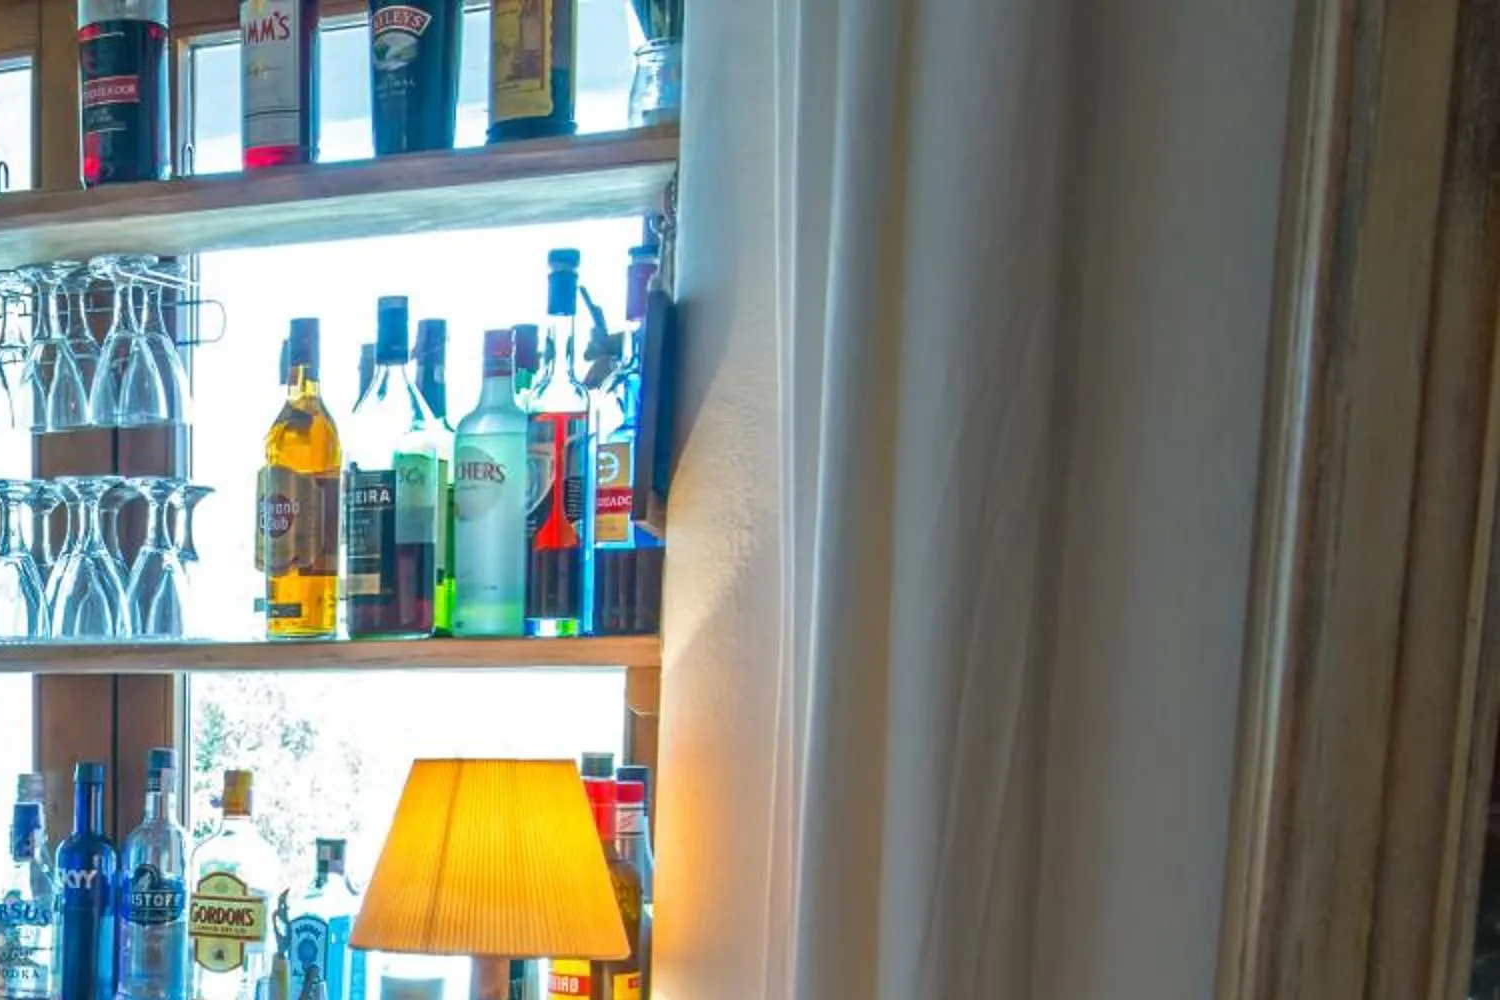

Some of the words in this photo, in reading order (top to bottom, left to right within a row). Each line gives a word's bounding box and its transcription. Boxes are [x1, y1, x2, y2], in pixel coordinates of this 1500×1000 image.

[242, 11, 290, 46] IMM'S
[374, 9, 424, 31] ILEYS
[455, 461, 507, 484] CHERS
